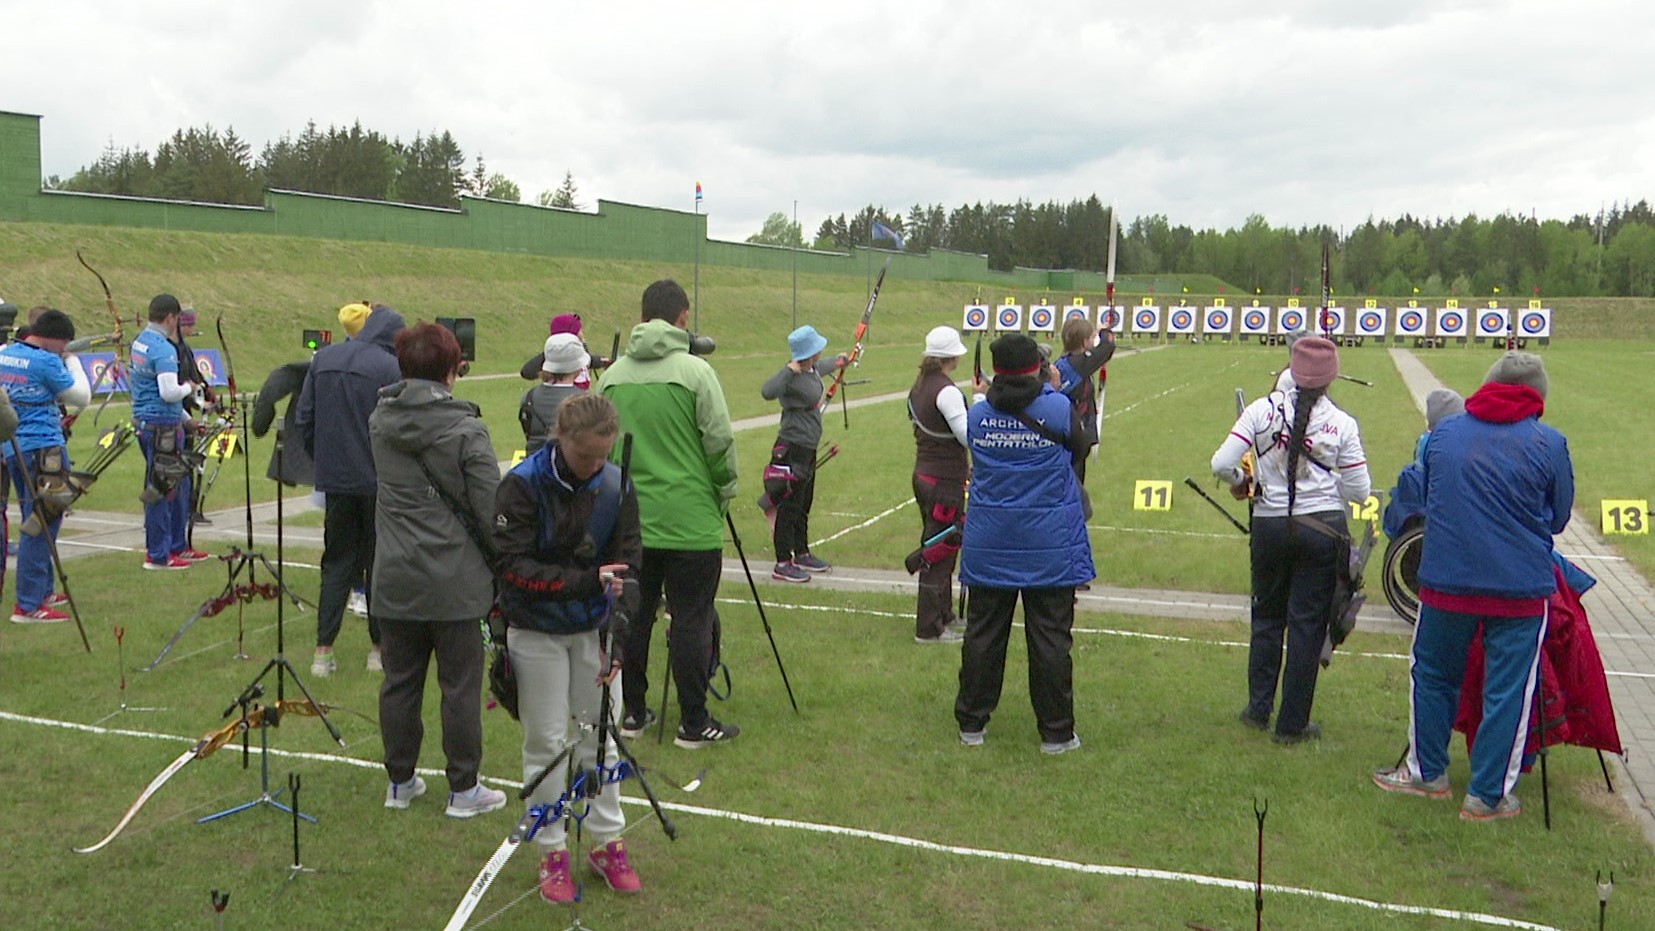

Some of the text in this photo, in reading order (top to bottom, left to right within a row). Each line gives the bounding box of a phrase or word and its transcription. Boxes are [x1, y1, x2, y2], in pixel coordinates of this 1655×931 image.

[985, 432, 1040, 441] MODERN
[1277, 433, 1313, 453] RS
[1140, 486, 1167, 507] 11
[1347, 495, 1379, 520] 12
[1608, 506, 1642, 532] 13
